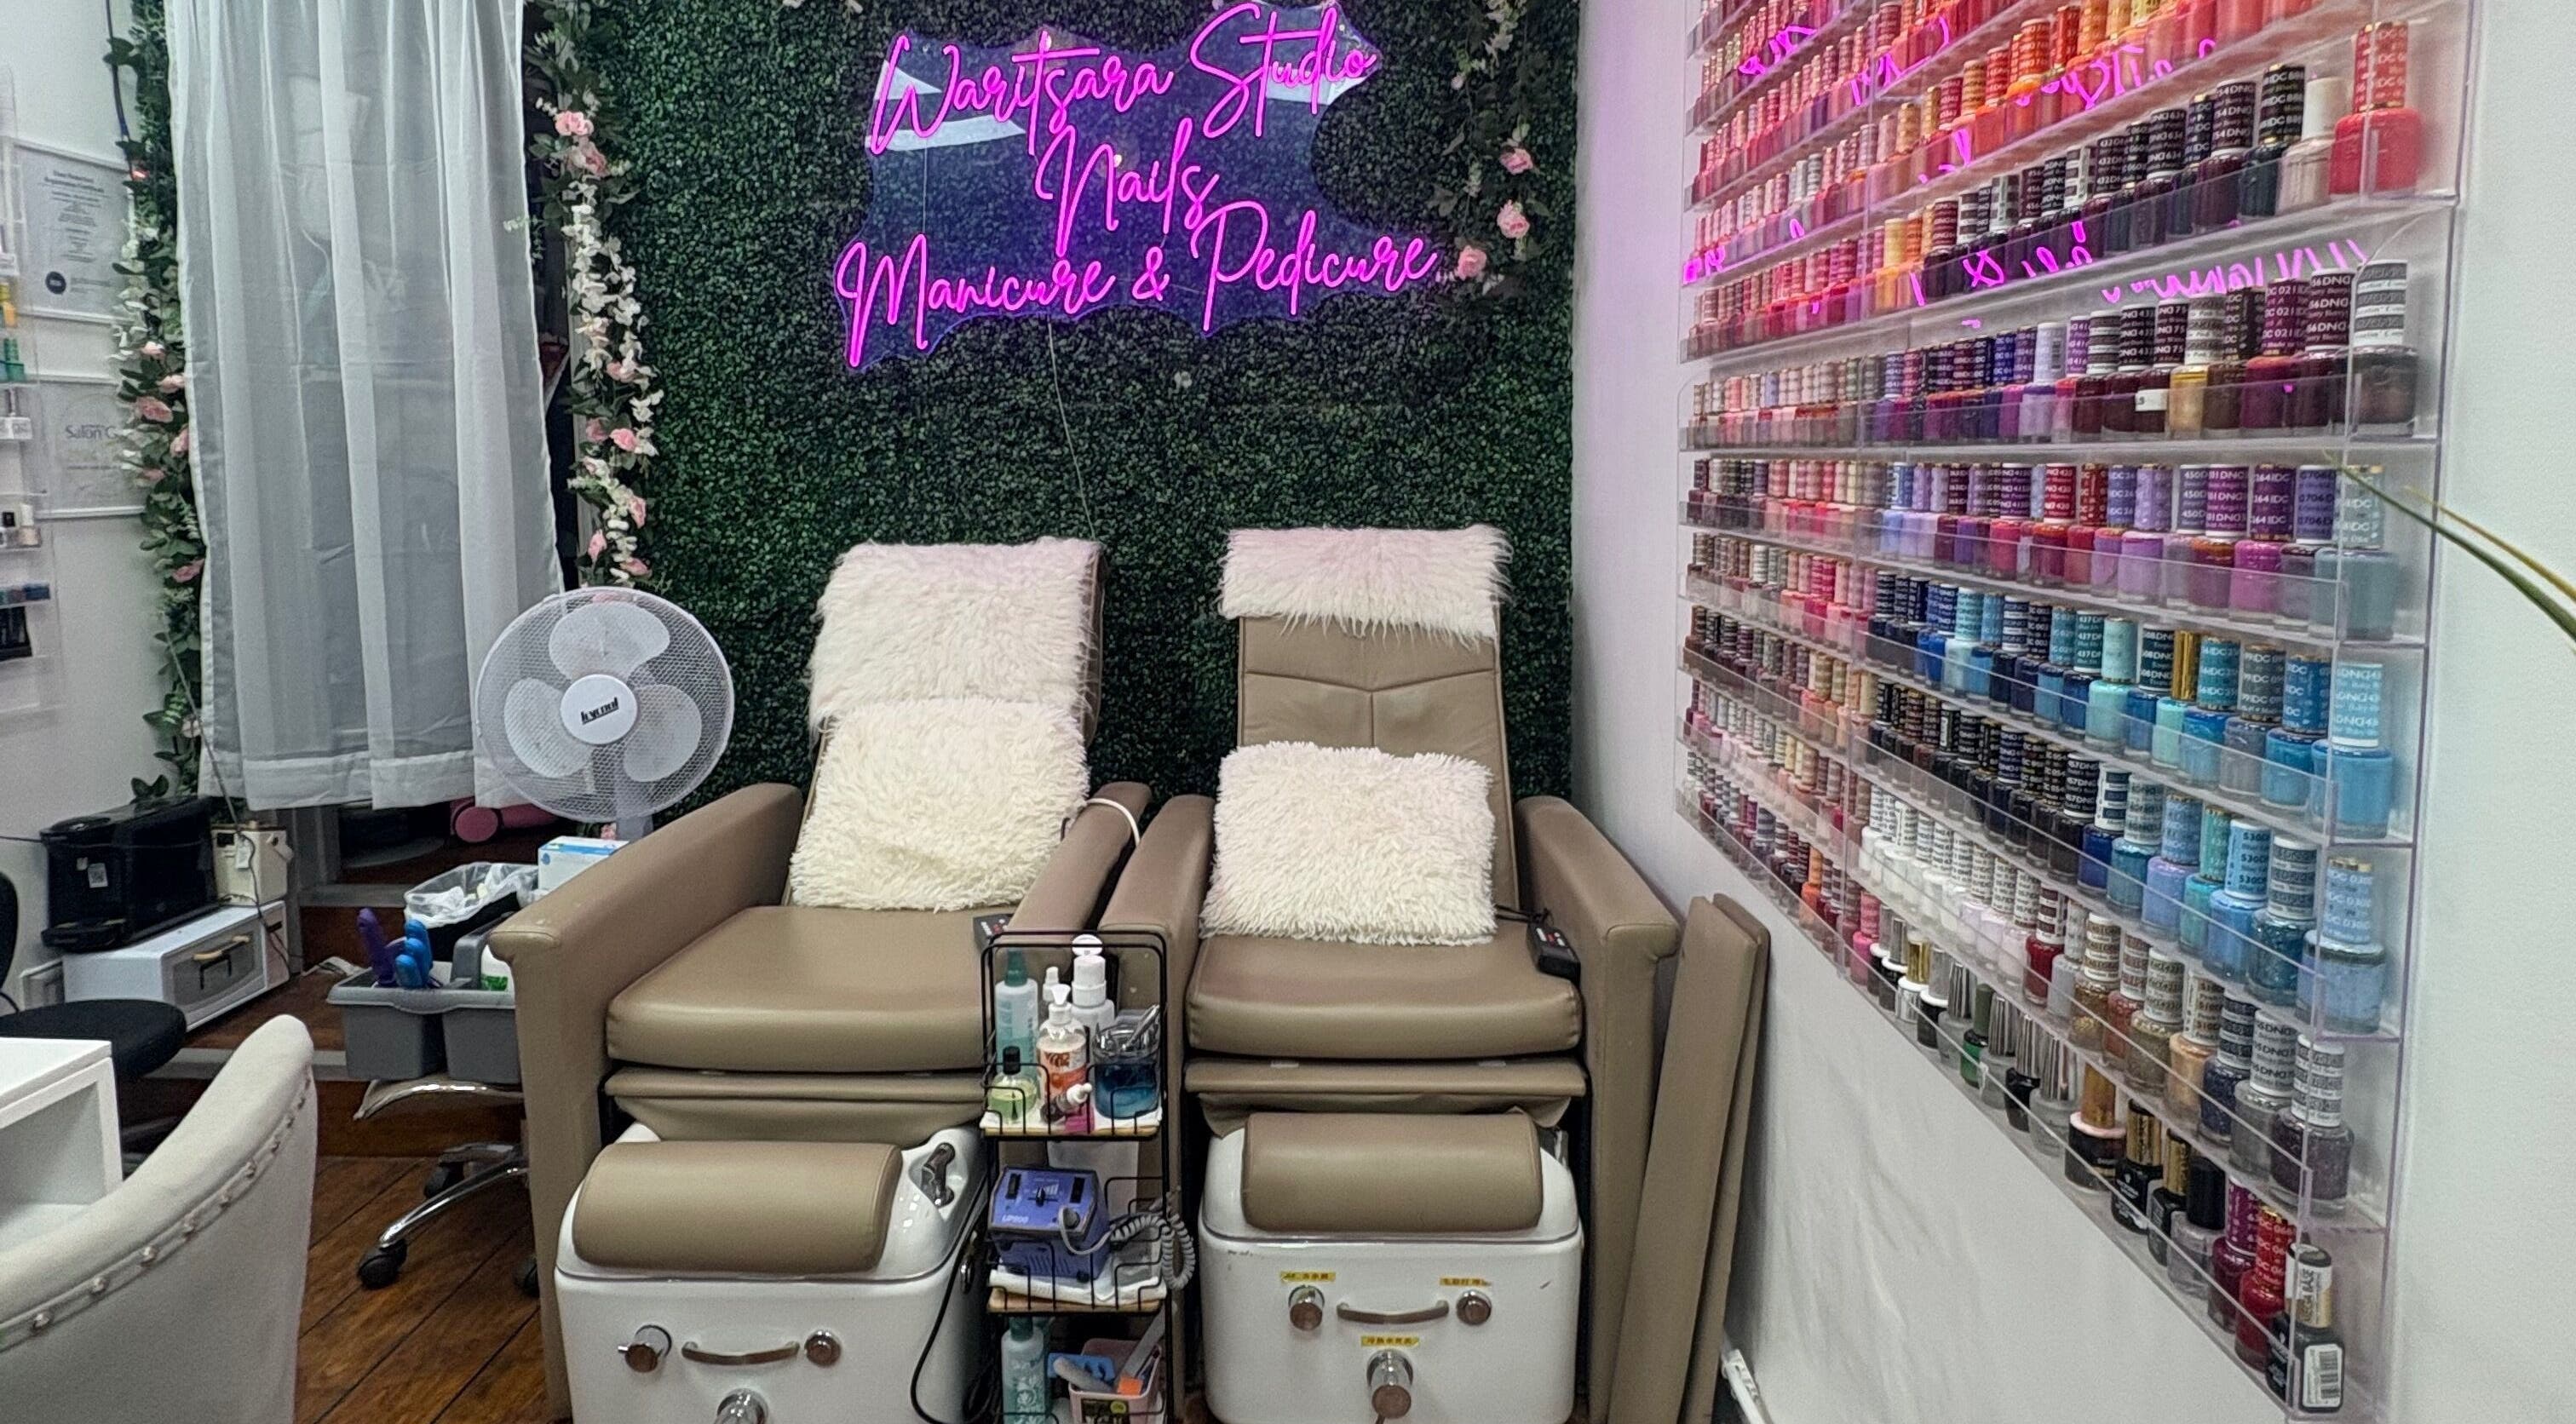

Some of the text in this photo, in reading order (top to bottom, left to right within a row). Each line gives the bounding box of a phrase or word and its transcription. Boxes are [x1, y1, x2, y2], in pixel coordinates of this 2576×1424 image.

[867, 2, 1377, 157] Waritsara Studio
[1034, 118, 1220, 257] Nails
[836, 200, 1438, 367] Manicure & Pedicure
